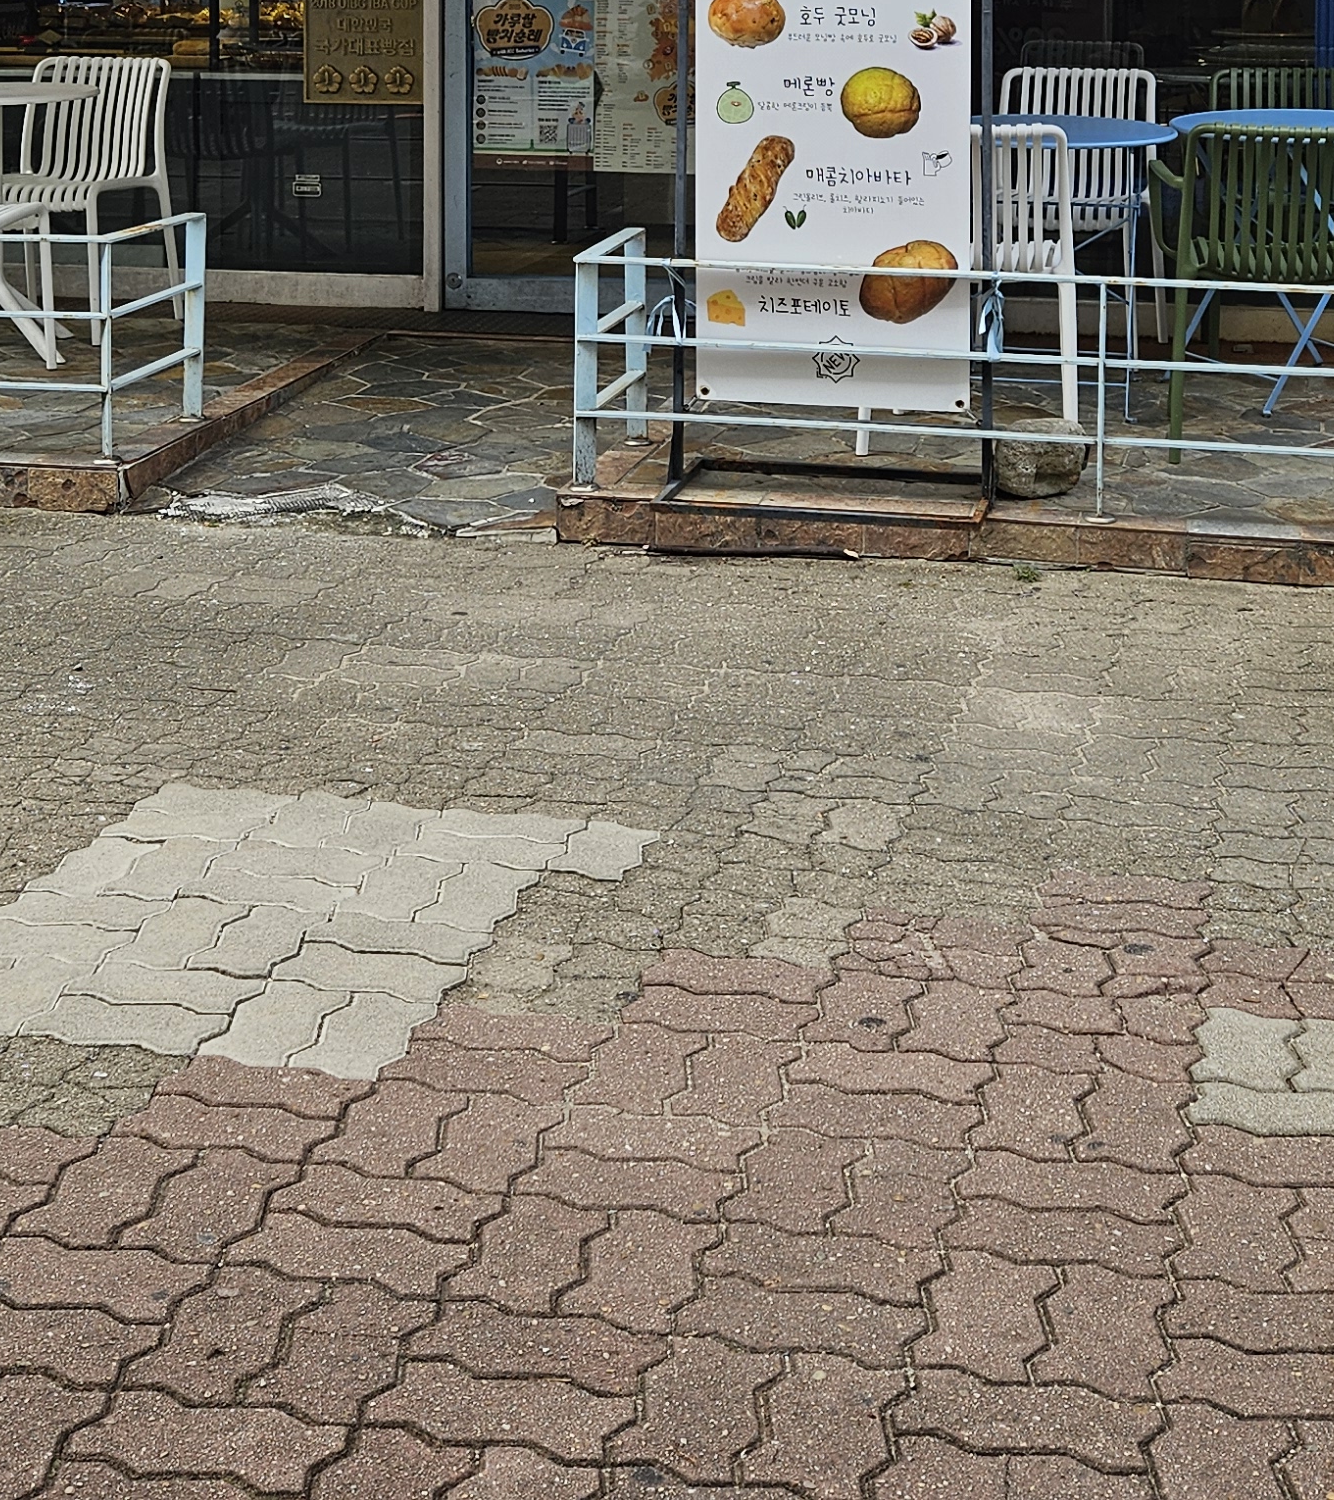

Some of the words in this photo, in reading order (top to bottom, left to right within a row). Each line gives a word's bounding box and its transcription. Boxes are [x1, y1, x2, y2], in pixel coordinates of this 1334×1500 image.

[337, 16, 393, 33] 대한민국
[800, 5, 825, 26] 호두
[834, 6, 876, 27] 굿모닝
[783, 76, 836, 97] 메론빵
[805, 167, 912, 187] 매콤치아바타
[758, 295, 851, 317] 치즈포테이토
